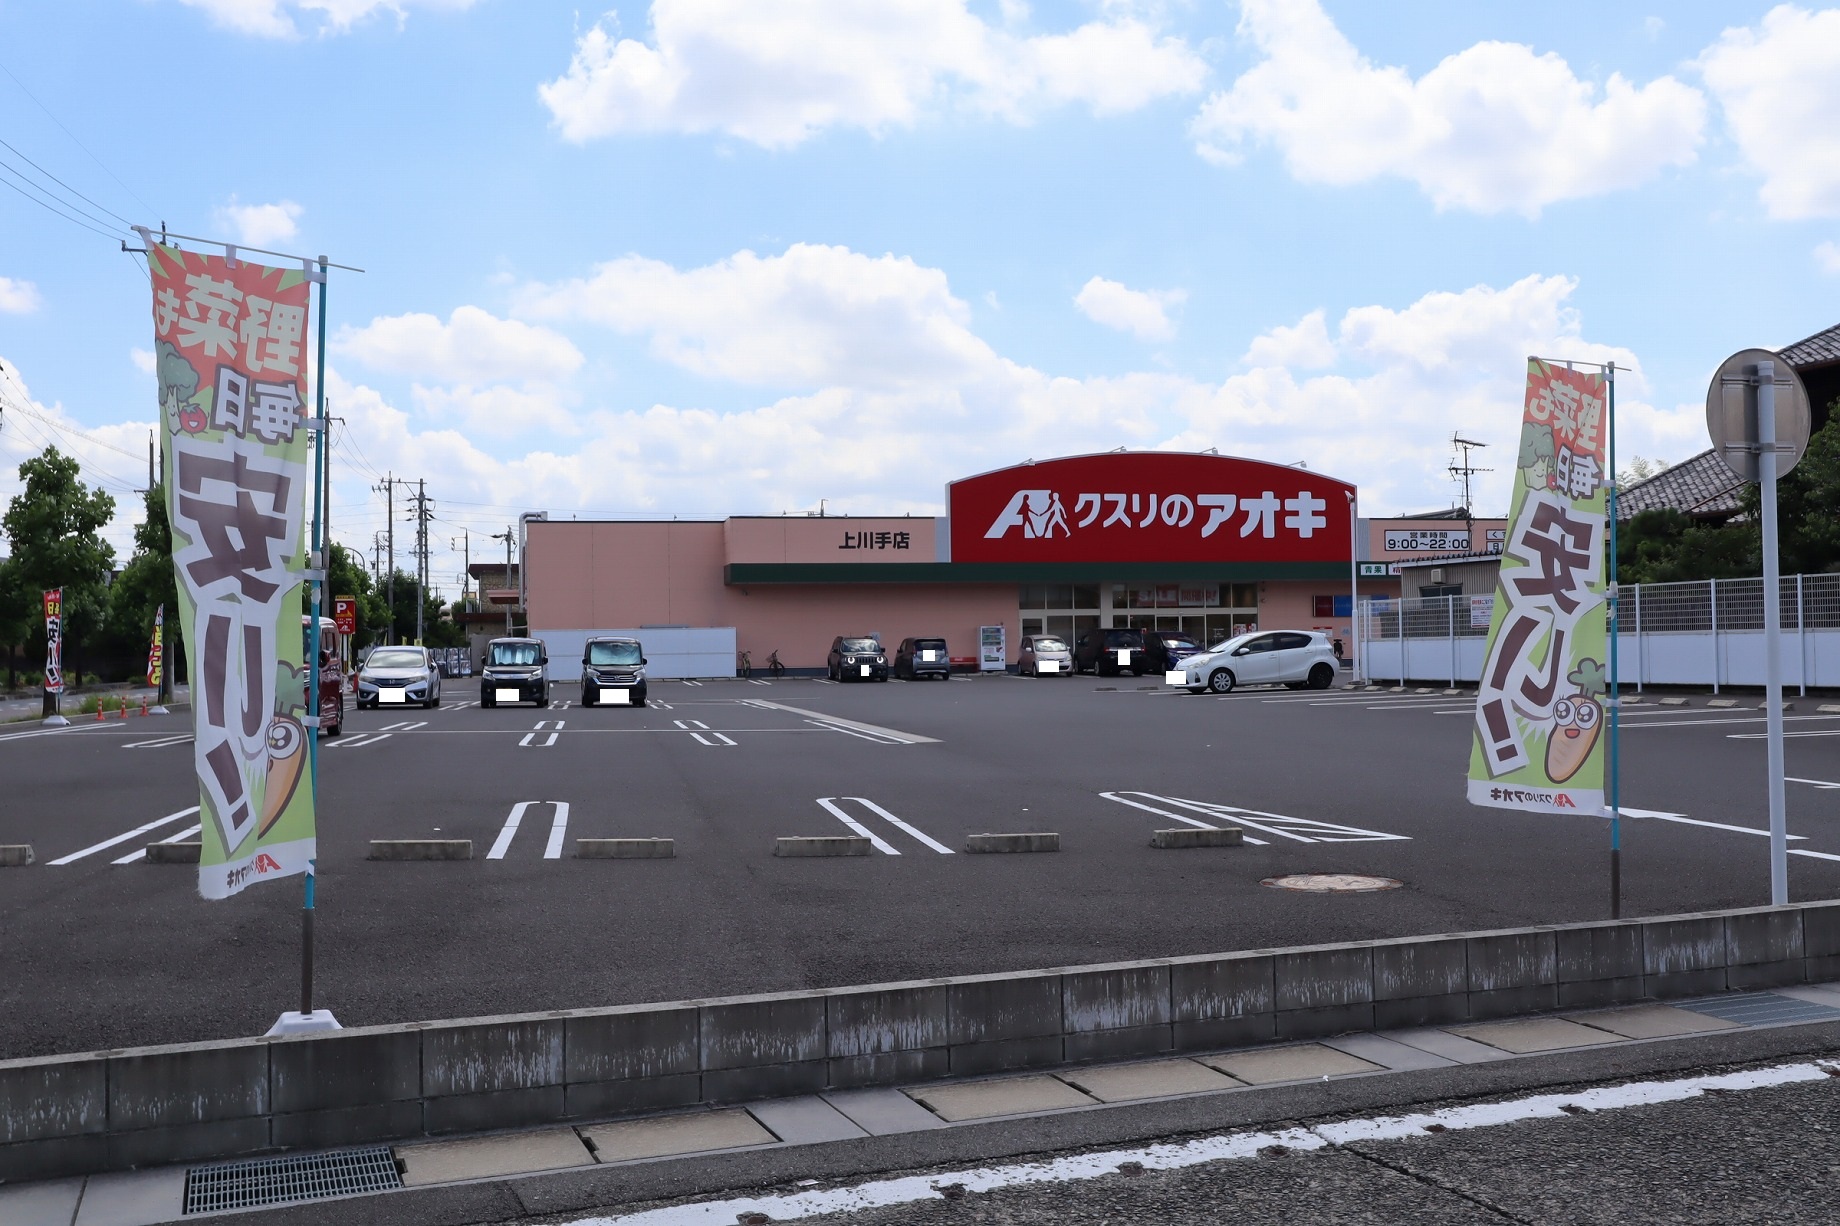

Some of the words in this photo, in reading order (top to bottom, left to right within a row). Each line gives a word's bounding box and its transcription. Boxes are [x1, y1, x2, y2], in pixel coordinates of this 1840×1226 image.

[1075, 490, 1327, 539] クスリのアオキ
[838, 531, 911, 551] 上川手店
[1409, 531, 1448, 539] 営業時間
[1364, 565, 1383, 574] 青果
[336, 602, 347, 614] P
